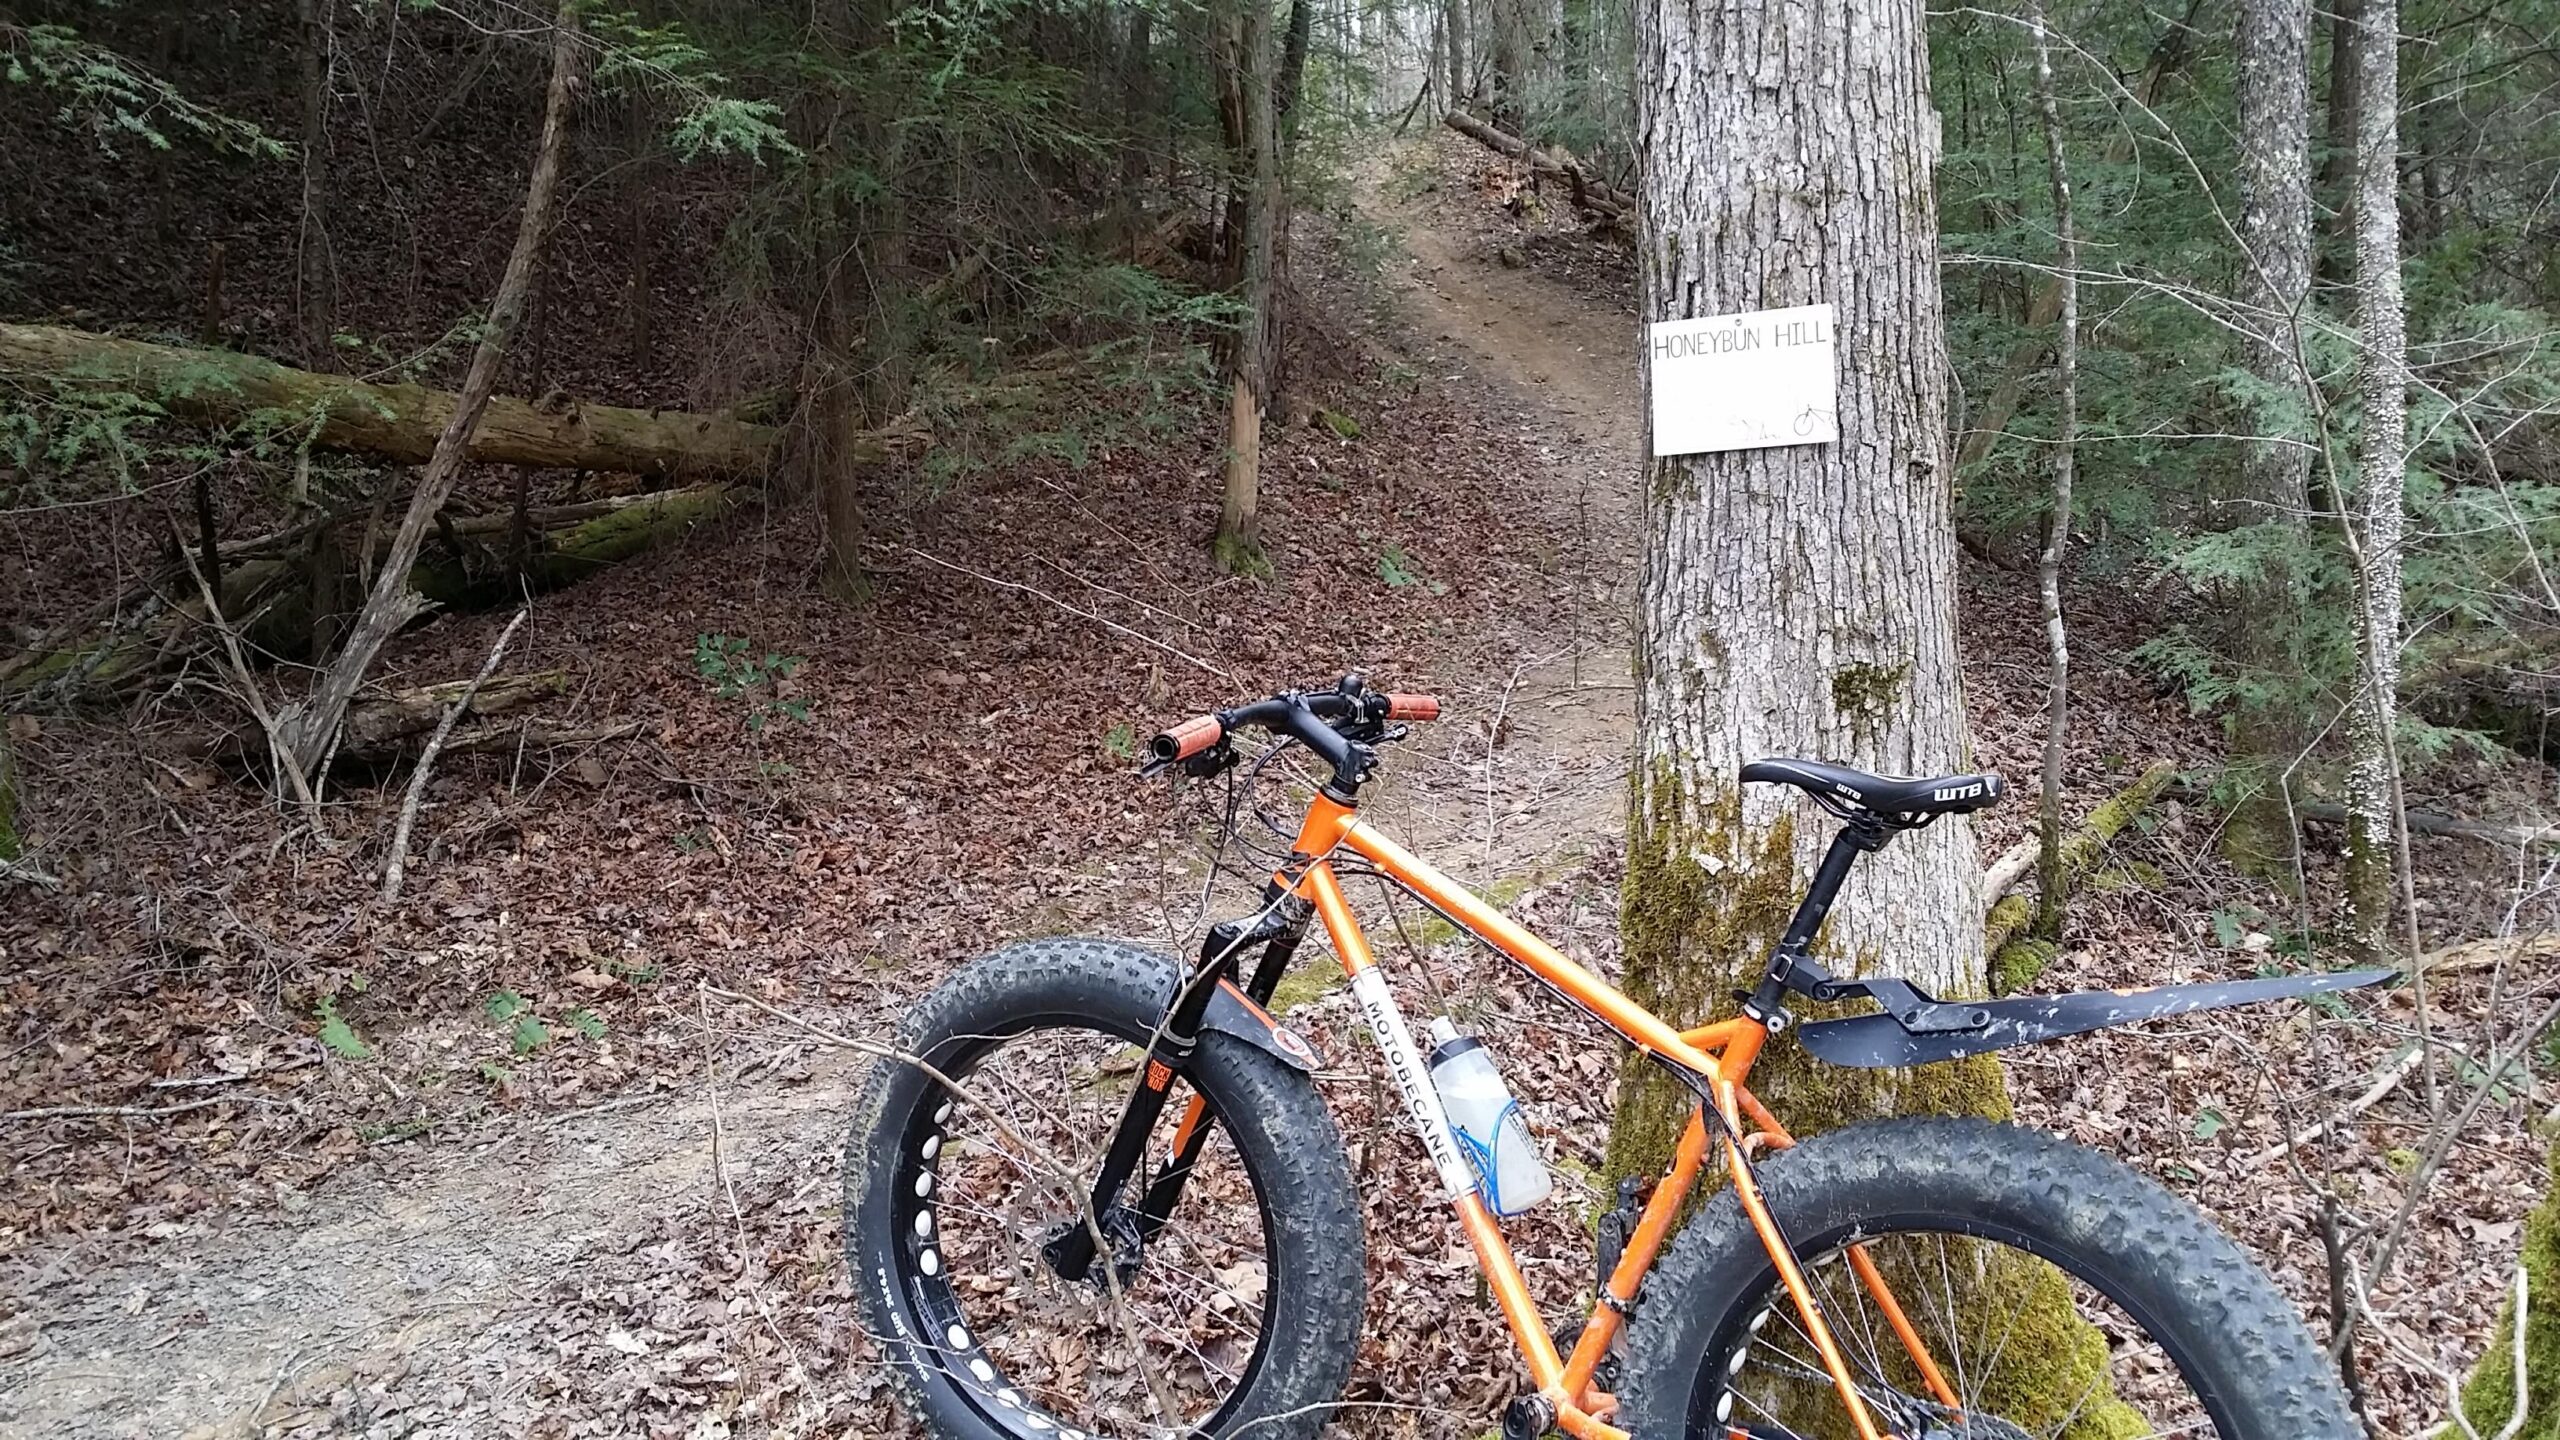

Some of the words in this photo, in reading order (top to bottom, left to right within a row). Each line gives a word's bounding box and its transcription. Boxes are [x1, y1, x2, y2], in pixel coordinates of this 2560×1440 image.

[1654, 327, 1760, 360] HONEYBUN
[1775, 320, 1827, 347] HILL
[1836, 782, 1862, 800] WTB
[1934, 782, 1983, 801] WTB
[1149, 1060, 1171, 1081] ROCK
[1367, 1001, 1453, 1170] MOTOBECANE
